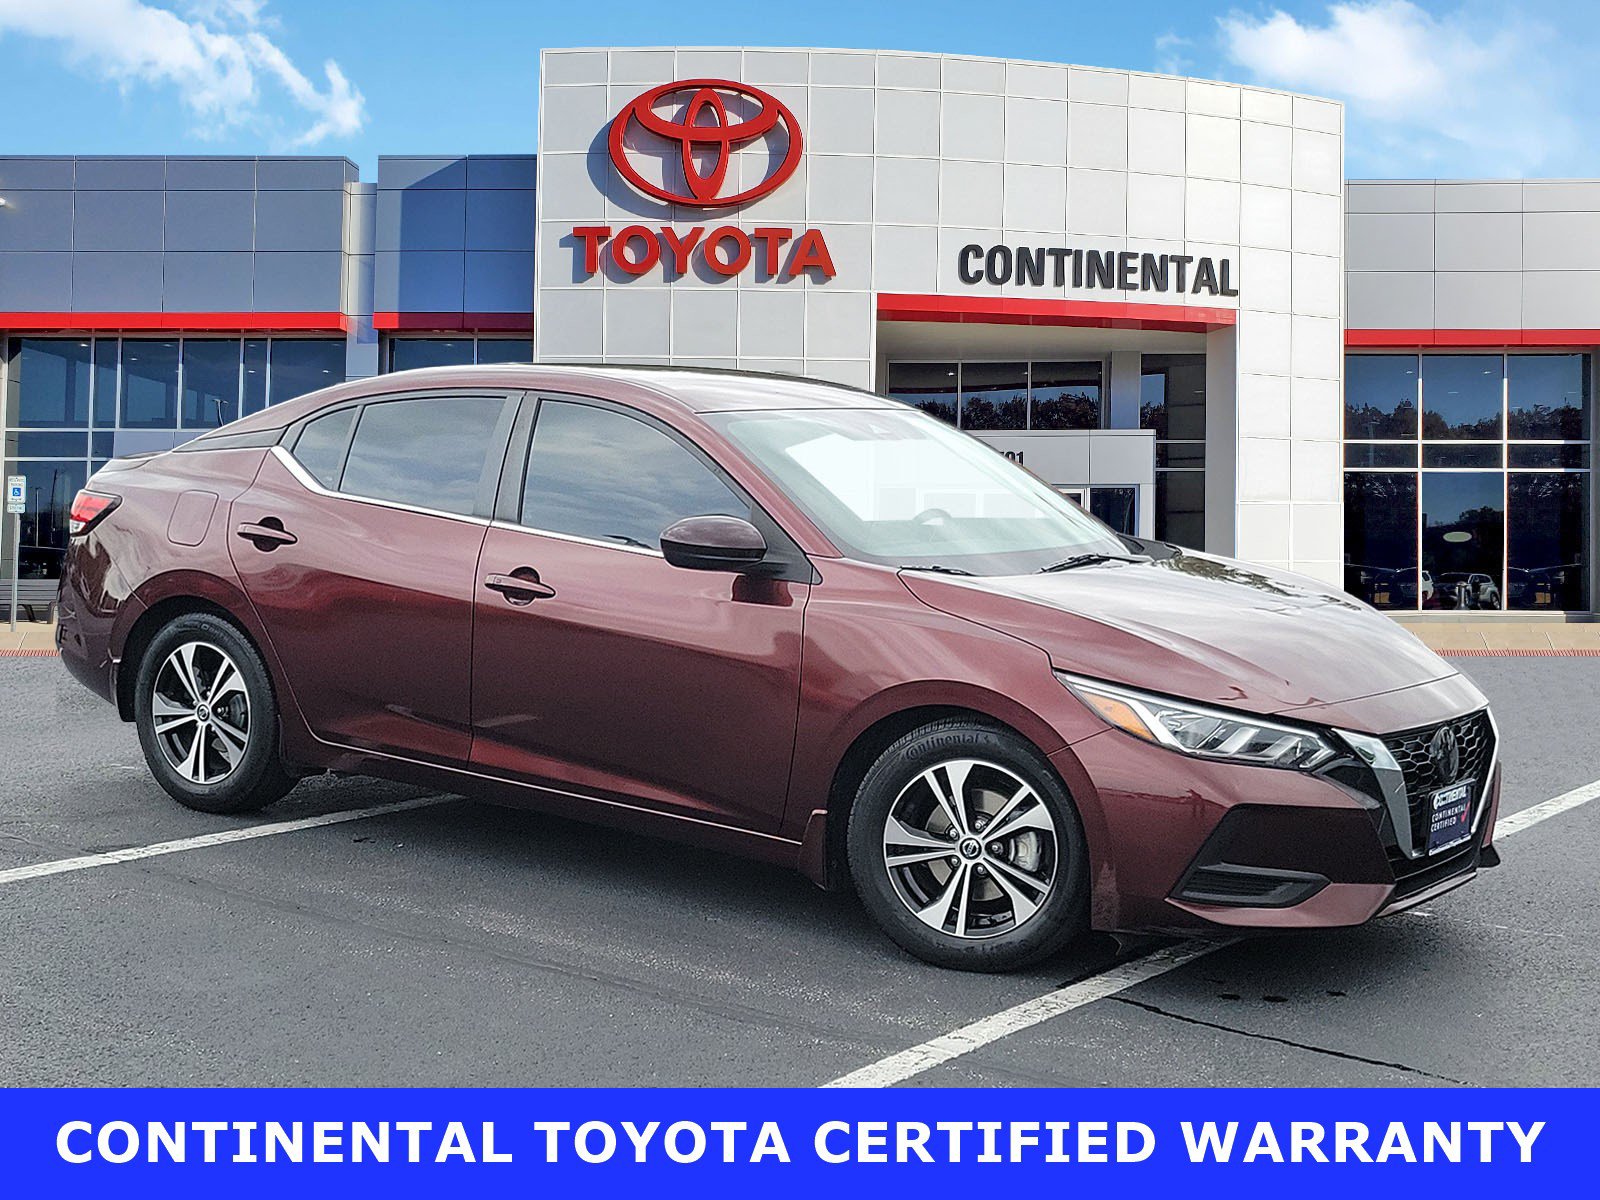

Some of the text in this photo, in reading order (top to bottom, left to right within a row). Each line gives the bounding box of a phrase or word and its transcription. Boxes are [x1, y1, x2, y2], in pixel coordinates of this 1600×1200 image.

[573, 225, 837, 277] TOYOTA
[957, 244, 1239, 297] CONTINENTAL
[1430, 816, 1457, 833] CERTIFIED
[1431, 803, 1466, 823] CONTINENTAL
